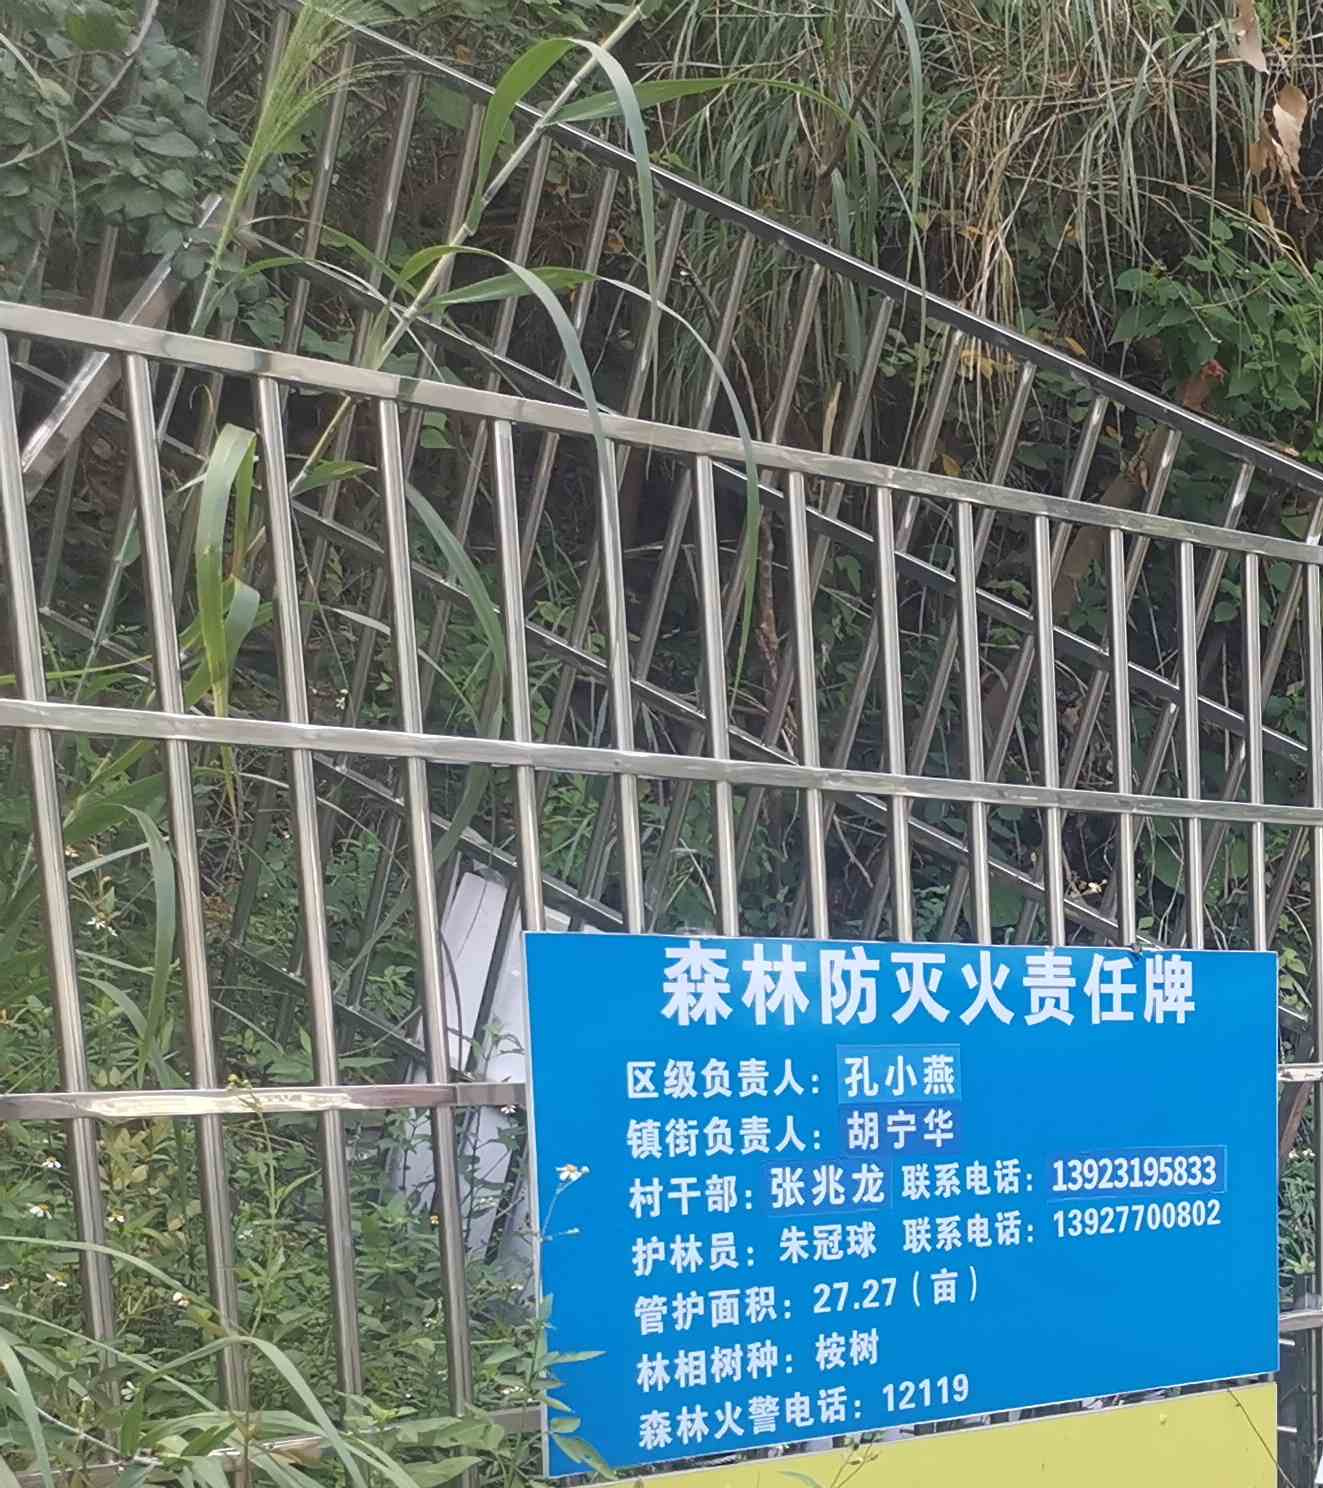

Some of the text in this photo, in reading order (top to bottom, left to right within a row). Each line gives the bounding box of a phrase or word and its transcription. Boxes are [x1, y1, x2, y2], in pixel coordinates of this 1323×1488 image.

[660, 939, 1198, 1026] 森林防灭火责任牌
